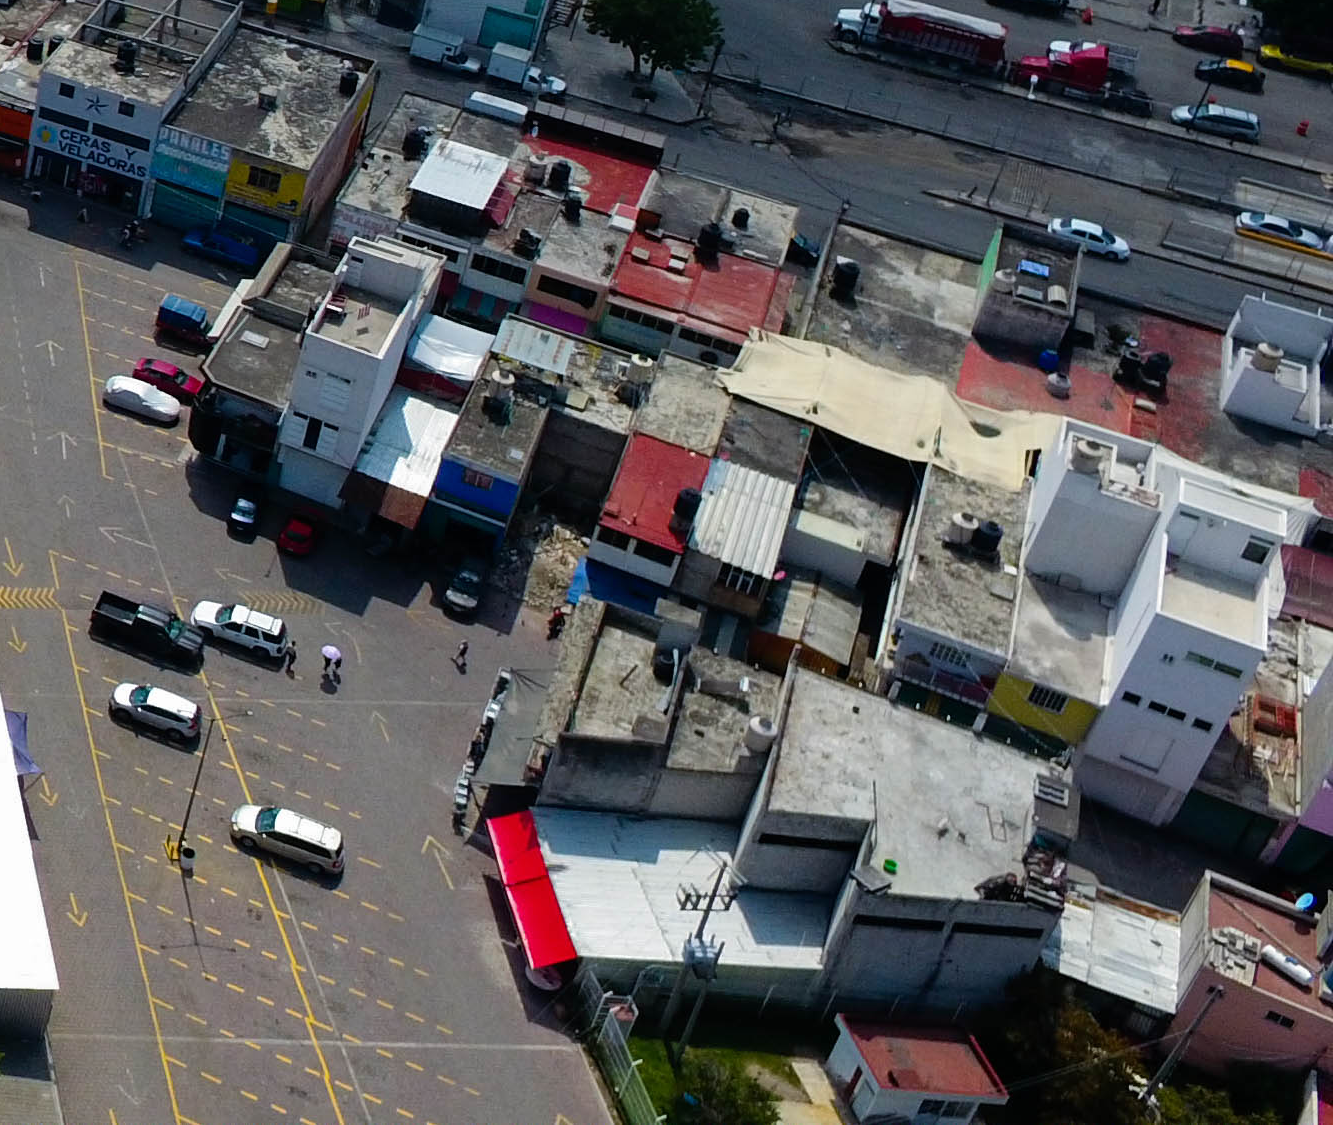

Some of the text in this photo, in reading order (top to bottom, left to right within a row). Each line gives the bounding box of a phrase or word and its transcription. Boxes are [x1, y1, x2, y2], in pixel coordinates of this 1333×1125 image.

[59, 141, 147, 177] VELADORAS
[60, 129, 111, 153] CERAS
[125, 148, 137, 160] Y
